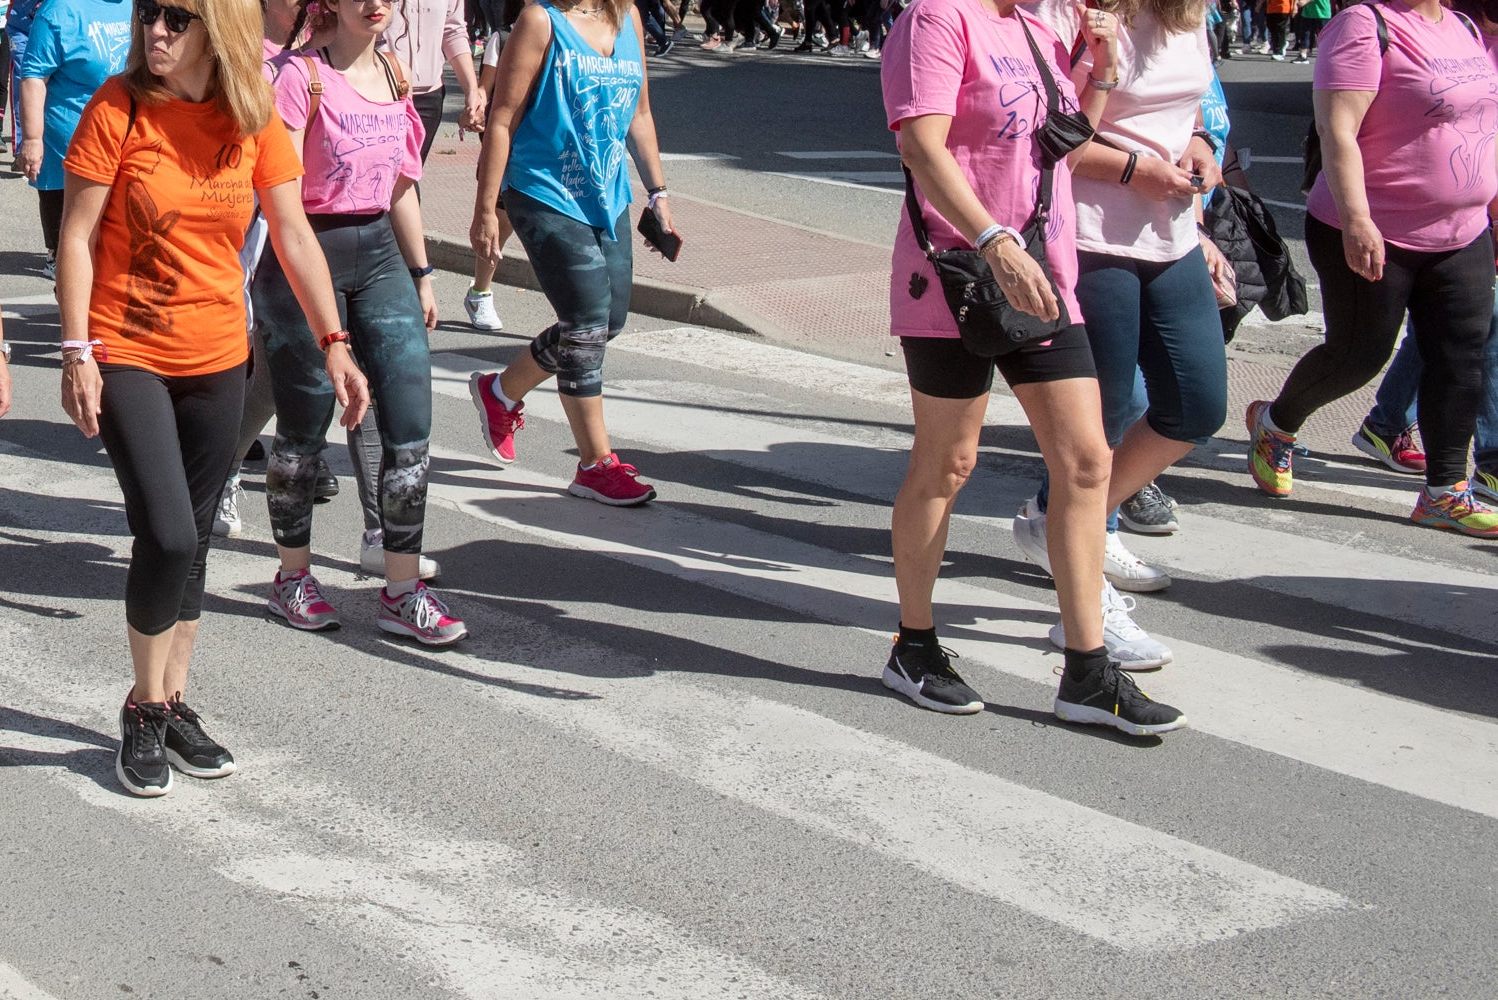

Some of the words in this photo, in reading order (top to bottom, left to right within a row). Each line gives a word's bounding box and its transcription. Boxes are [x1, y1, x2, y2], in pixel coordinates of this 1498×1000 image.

[577, 53, 615, 76] MARCHA
[575, 76, 641, 94] SEGOVIA
[339, 112, 381, 135] MARCHA
[214, 143, 242, 169] 10
[190, 175, 243, 192] Marcha
